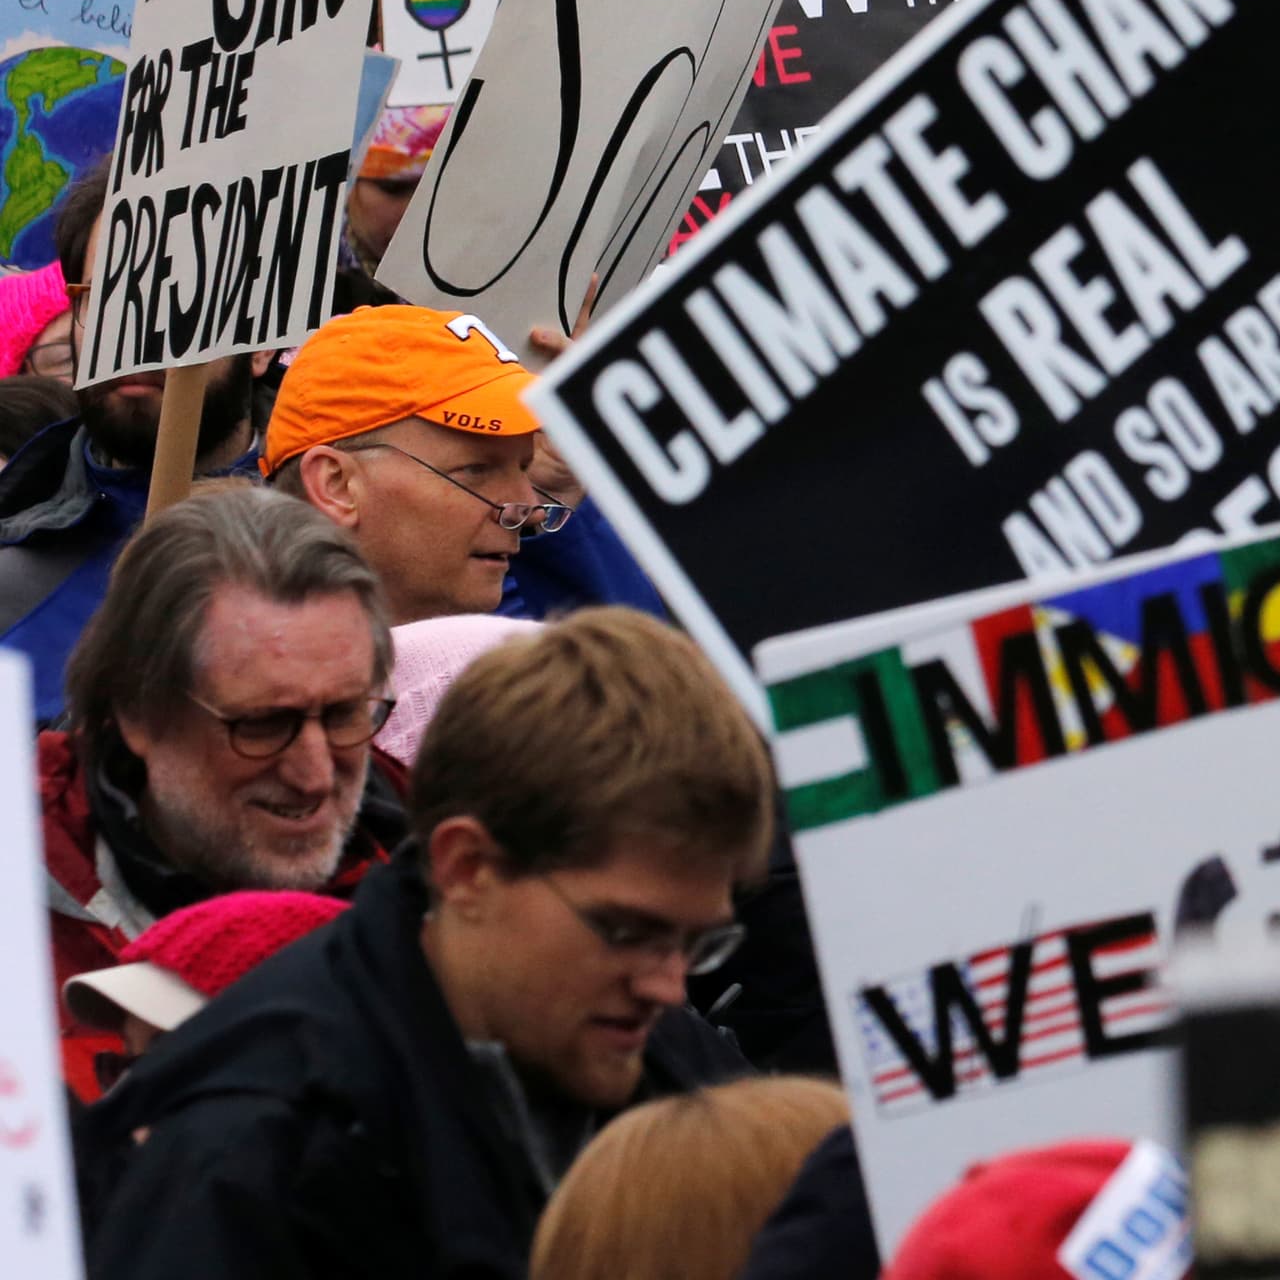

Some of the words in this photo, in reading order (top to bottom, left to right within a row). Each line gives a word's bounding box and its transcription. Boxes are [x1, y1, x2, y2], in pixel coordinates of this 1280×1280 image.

[112, 47, 175, 193] FOR
[179, 36, 256, 152] THE
[87, 149, 351, 382] PRESIDENT
[591, 92, 1007, 507] CLIMATE
[921, 351, 1020, 468] IS
[977, 156, 1251, 422] REAL
[440, 409, 504, 434] VOLS
[1000, 450, 1144, 583] AND
[1113, 376, 1224, 502] SO
[856, 912, 1182, 1102] WE
